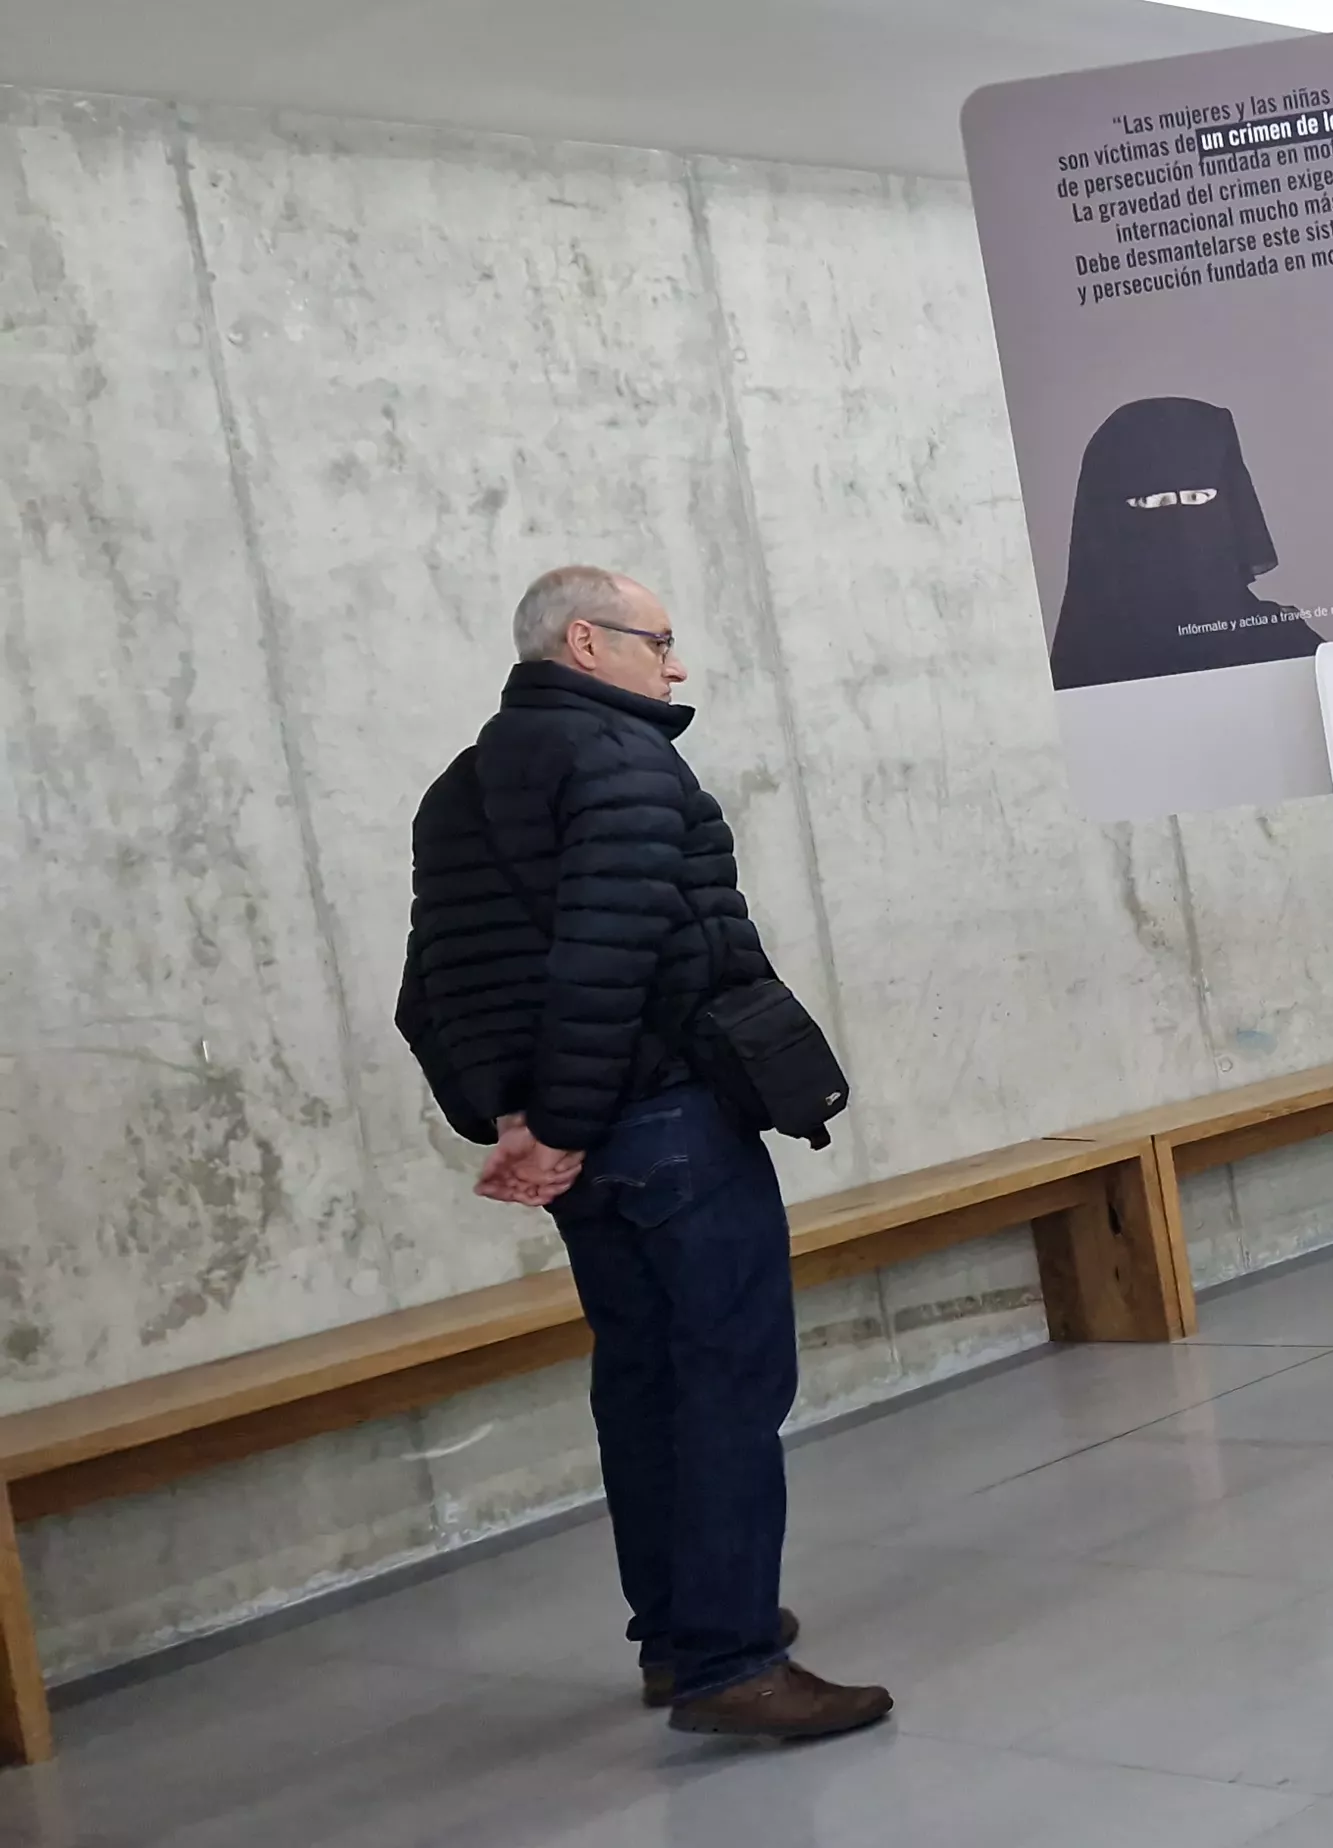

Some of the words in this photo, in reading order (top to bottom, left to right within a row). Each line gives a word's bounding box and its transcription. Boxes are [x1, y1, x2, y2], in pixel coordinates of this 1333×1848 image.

[1158, 104, 1230, 130] mujeres
[1234, 101, 1244, 122] y
[1249, 95, 1277, 114] las
[1282, 88, 1330, 109] niñas
[1057, 152, 1089, 171] son
[1093, 140, 1169, 165] víctimas
[1174, 133, 1195, 154] de
[1200, 131, 1224, 150] un
[1228, 121, 1291, 146] crimen
[1296, 114, 1318, 135] de
[1056, 177, 1079, 198] de
[1083, 160, 1193, 198] persecución
[1197, 151, 1270, 177] fundada
[1276, 148, 1298, 165] en
[1071, 202, 1093, 223] La
[1098, 187, 1181, 223] gravedad
[1186, 182, 1213, 206] del
[1218, 177, 1281, 201] crimen
[1286, 168, 1333, 191] exige
[1115, 206, 1234, 243] internacional
[1238, 199, 1298, 225] mucho
[1075, 252, 1120, 275] Debe
[1125, 234, 1256, 268] desmantelarse
[1262, 225, 1300, 248] este
[1076, 285, 1086, 306] y
[1092, 265, 1202, 303] persecución
[1206, 255, 1278, 282] fundada
[1284, 254, 1306, 271] en
[1229, 619, 1237, 631] y
[1270, 614, 1278, 623] a
[1279, 609, 1312, 622] través
[1313, 606, 1327, 617] de
